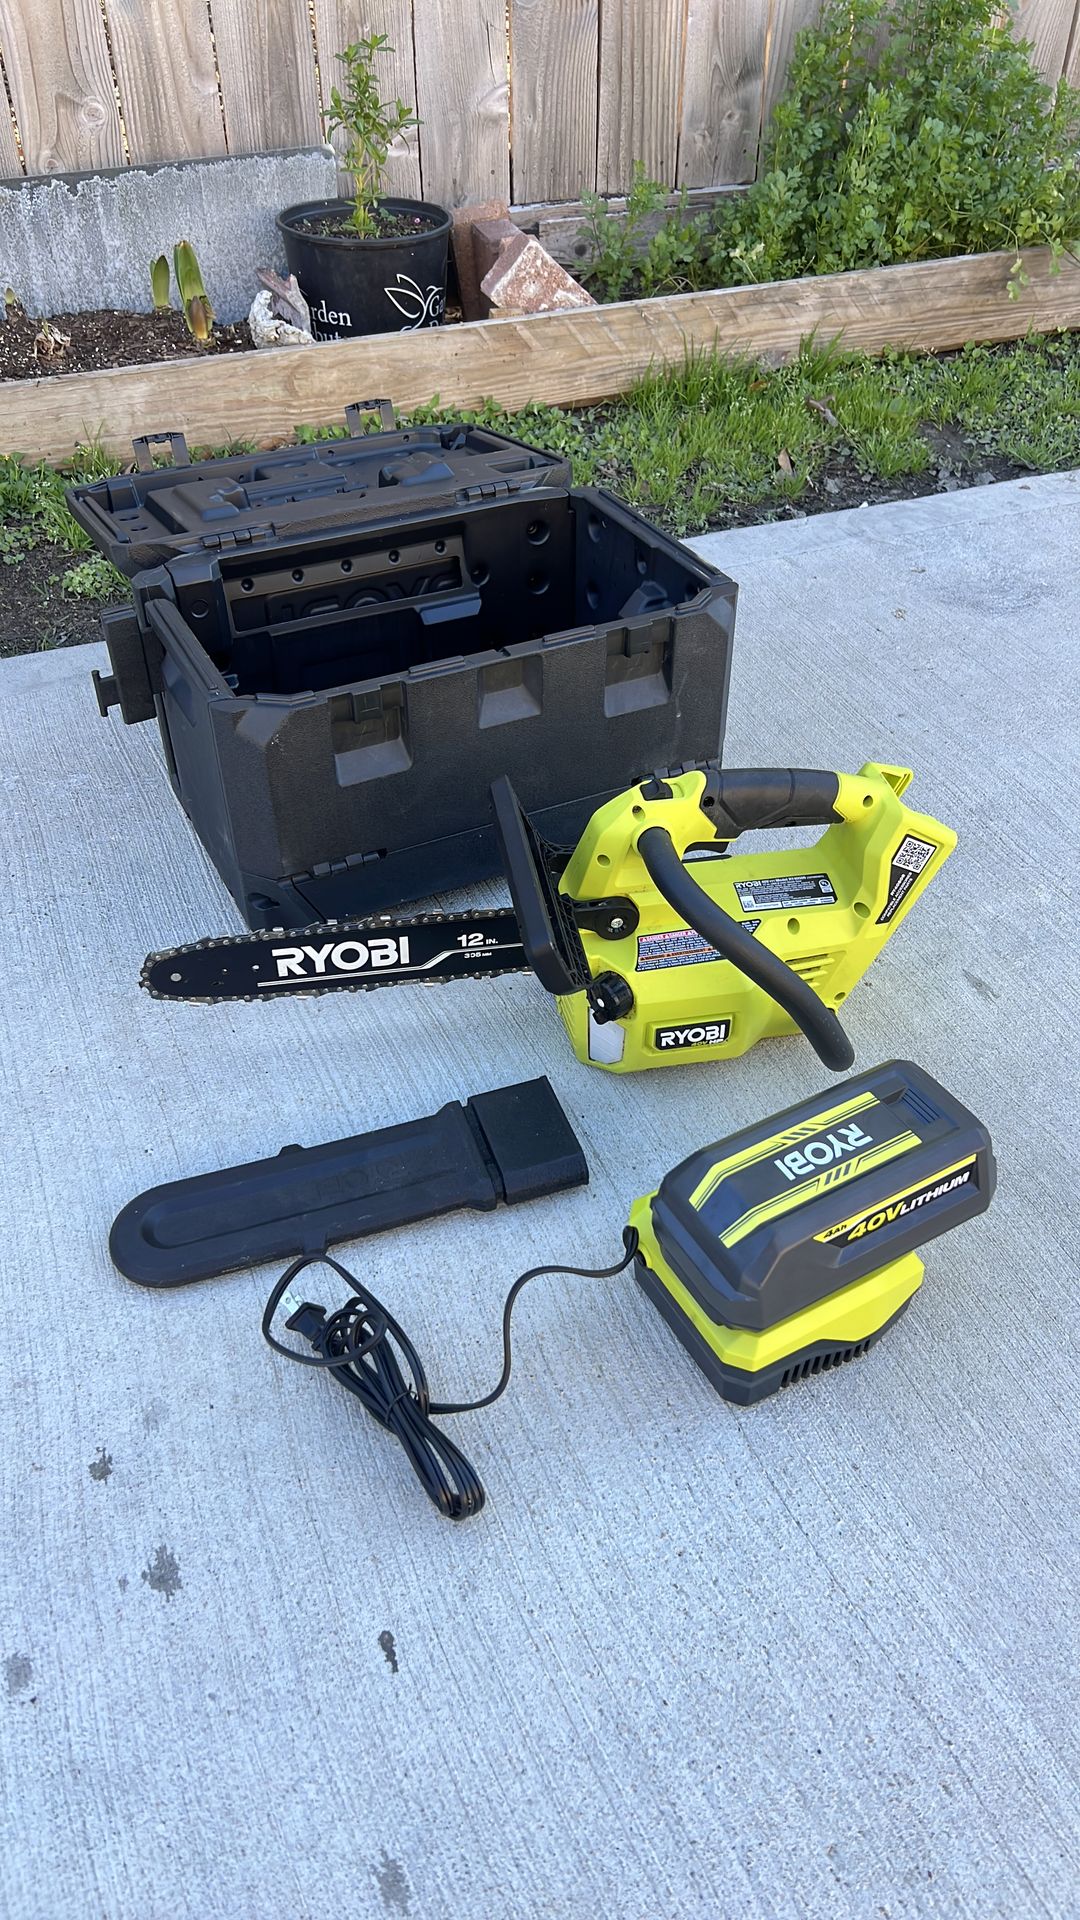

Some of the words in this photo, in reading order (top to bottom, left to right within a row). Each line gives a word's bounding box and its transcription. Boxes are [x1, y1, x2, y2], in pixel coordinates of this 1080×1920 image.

[310, 300, 352, 327] rden
[735, 881, 762, 889] RYOBI
[457, 932, 484, 947] 12
[271, 936, 410, 978] RYOBI
[660, 1024, 726, 1047] RYOBI
[773, 1123, 874, 1182] RYOBI
